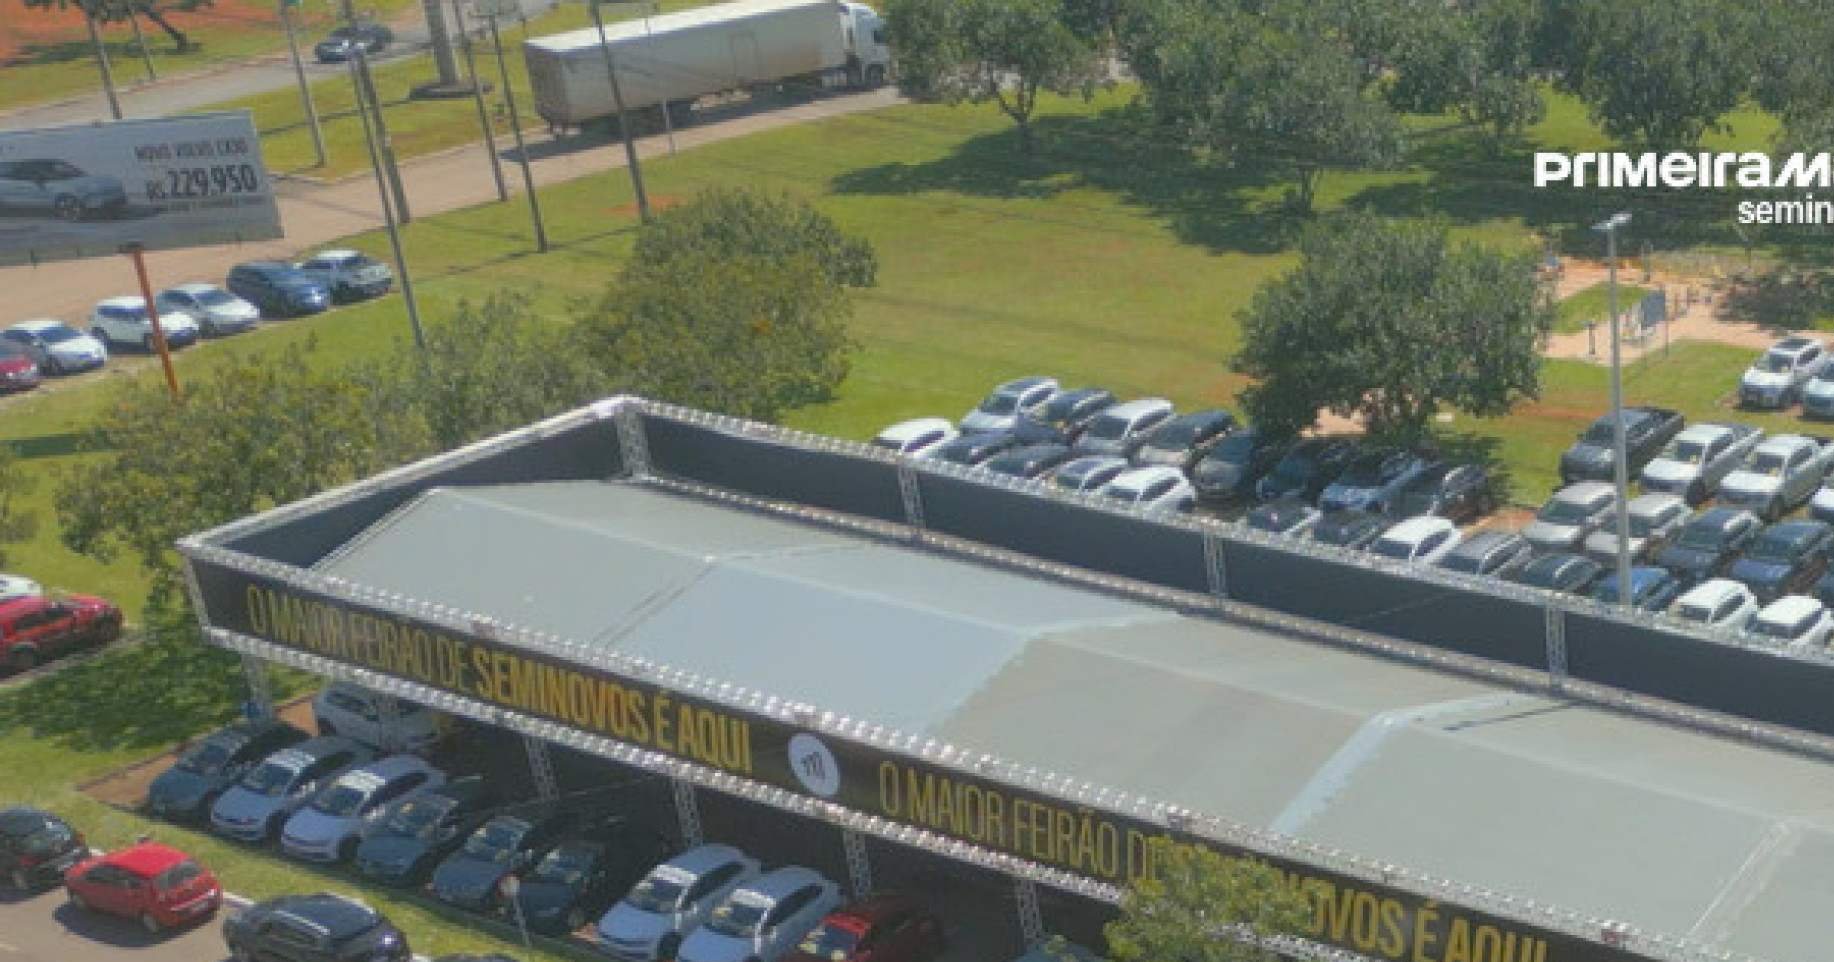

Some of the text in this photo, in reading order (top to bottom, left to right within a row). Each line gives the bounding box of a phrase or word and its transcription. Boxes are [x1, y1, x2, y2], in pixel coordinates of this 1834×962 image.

[436, 634, 464, 690] DE
[472, 646, 650, 745] SEMINOVOS
[677, 703, 752, 774] AQUI
[879, 760, 900, 816] O
[907, 766, 1006, 842] MAIOR
[1013, 798, 1118, 880] FEIRÃO
